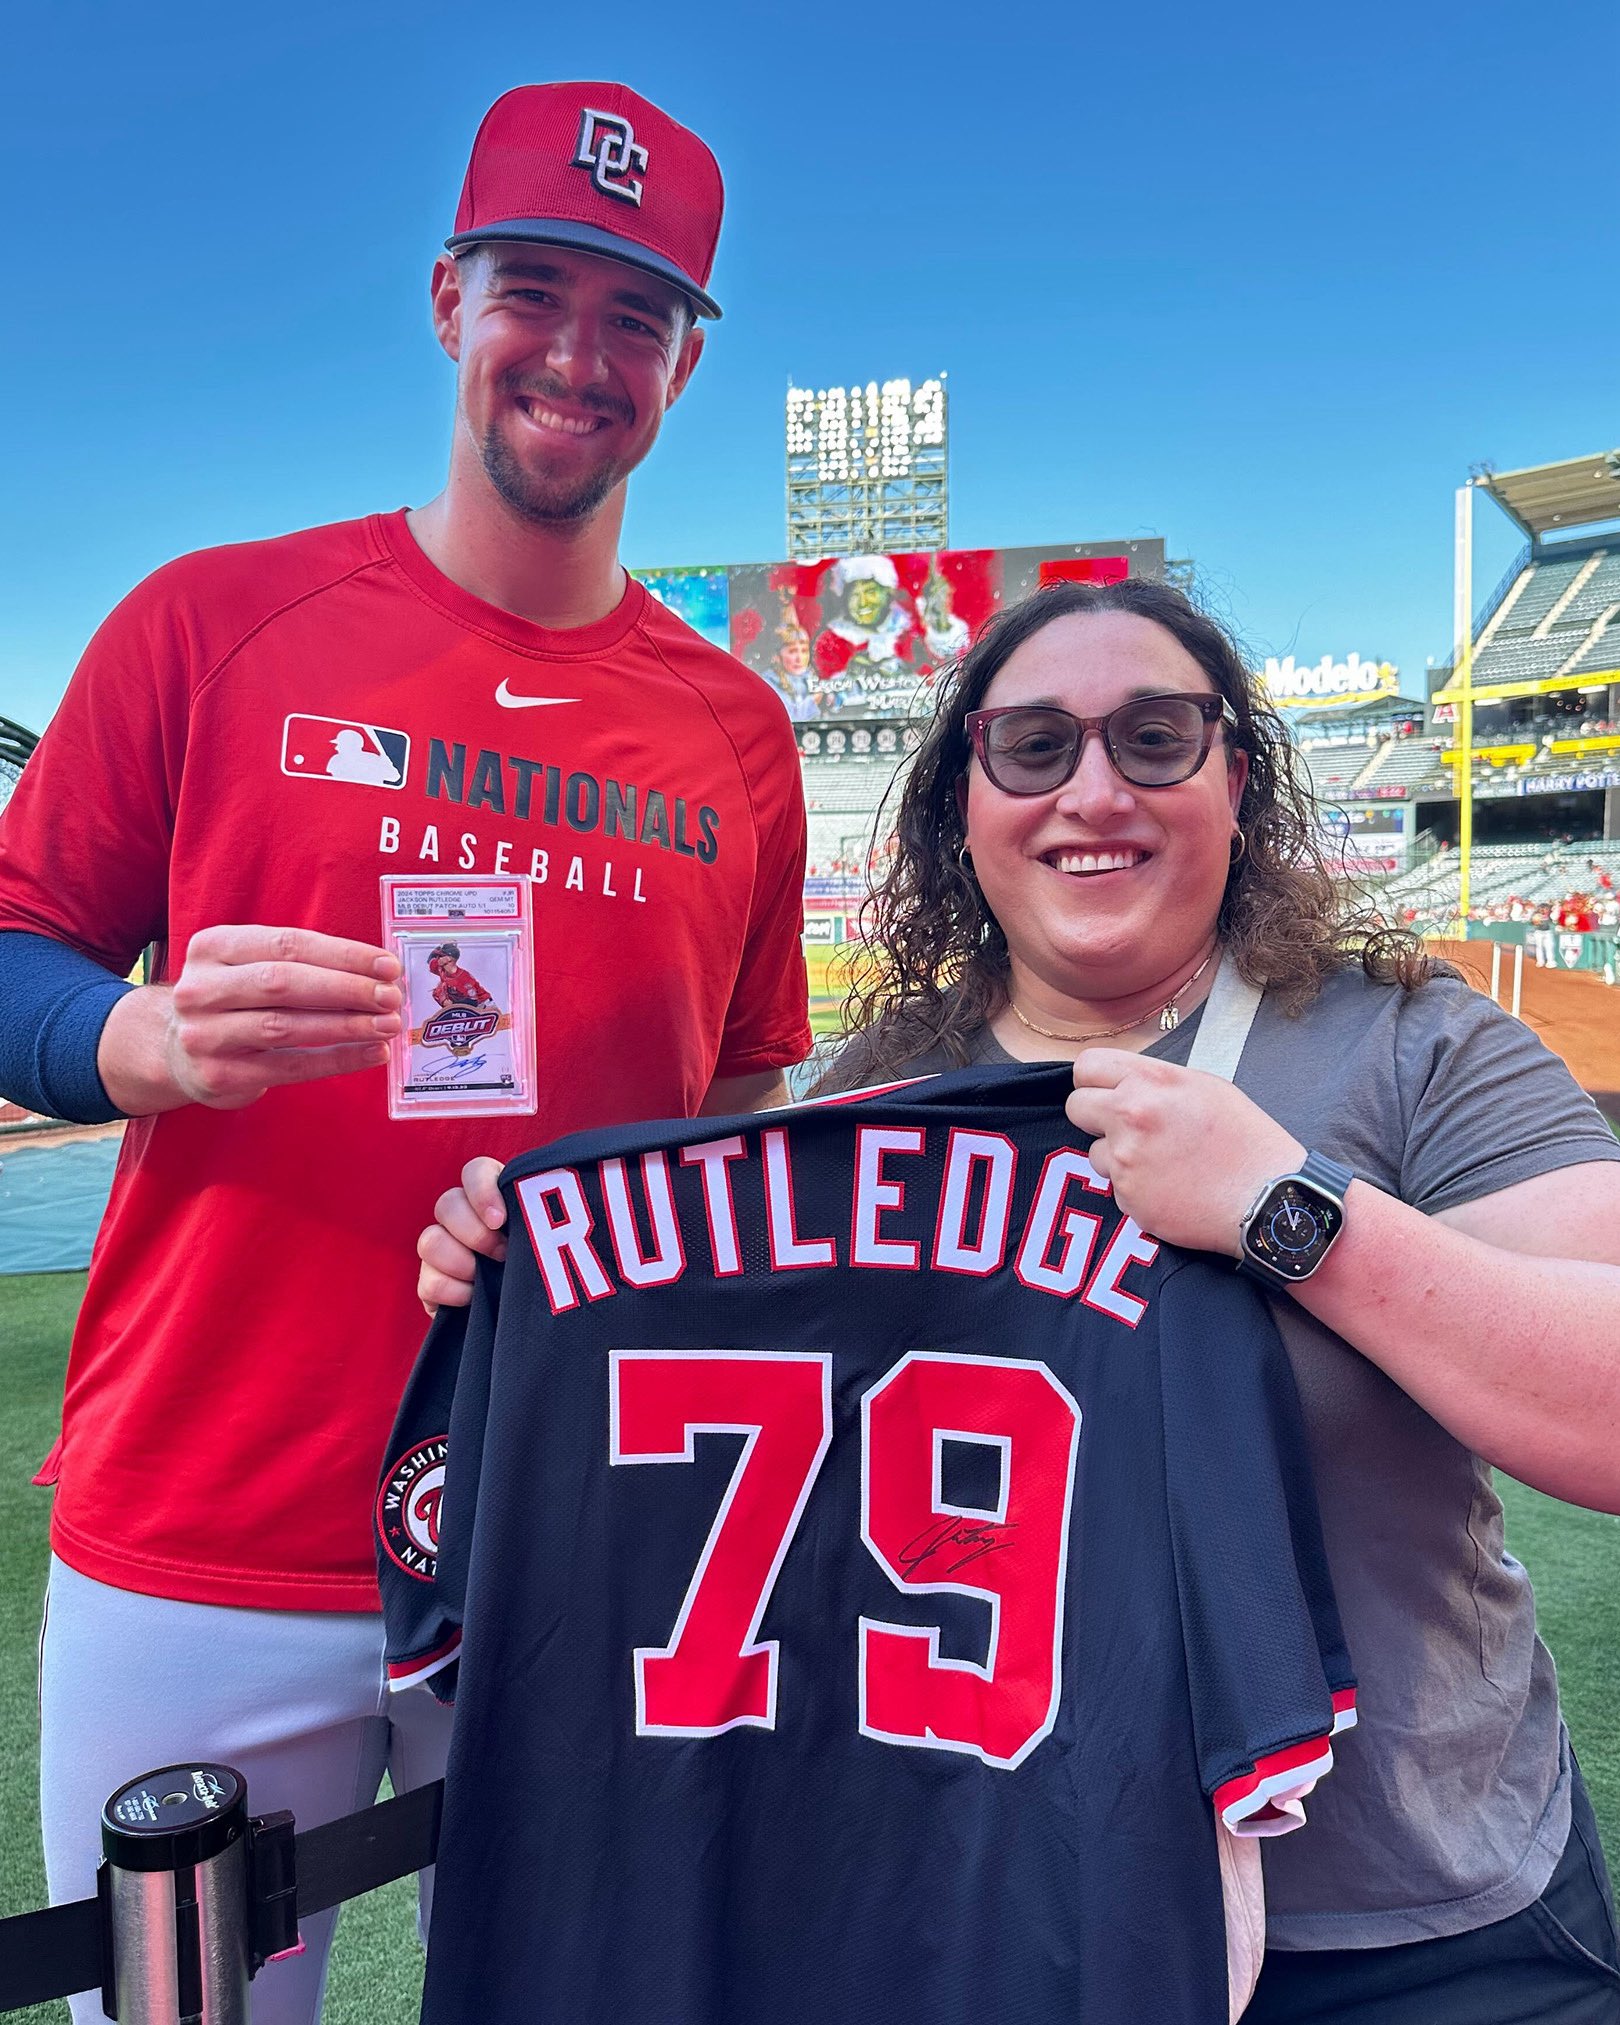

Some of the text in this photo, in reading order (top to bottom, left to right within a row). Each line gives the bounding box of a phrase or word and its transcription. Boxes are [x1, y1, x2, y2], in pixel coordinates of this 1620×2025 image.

[569, 108, 649, 208] DC
[1264, 652, 1378, 696] Modelo
[425, 737, 720, 865] NATIONALS
[1526, 774, 1573, 794] HARRY
[379, 816, 648, 903] BASEBALL
[429, 1019, 492, 1037] DEBUT
[514, 1124, 1160, 1330] RUTLEDGE
[608, 1349, 1083, 1772] 79
